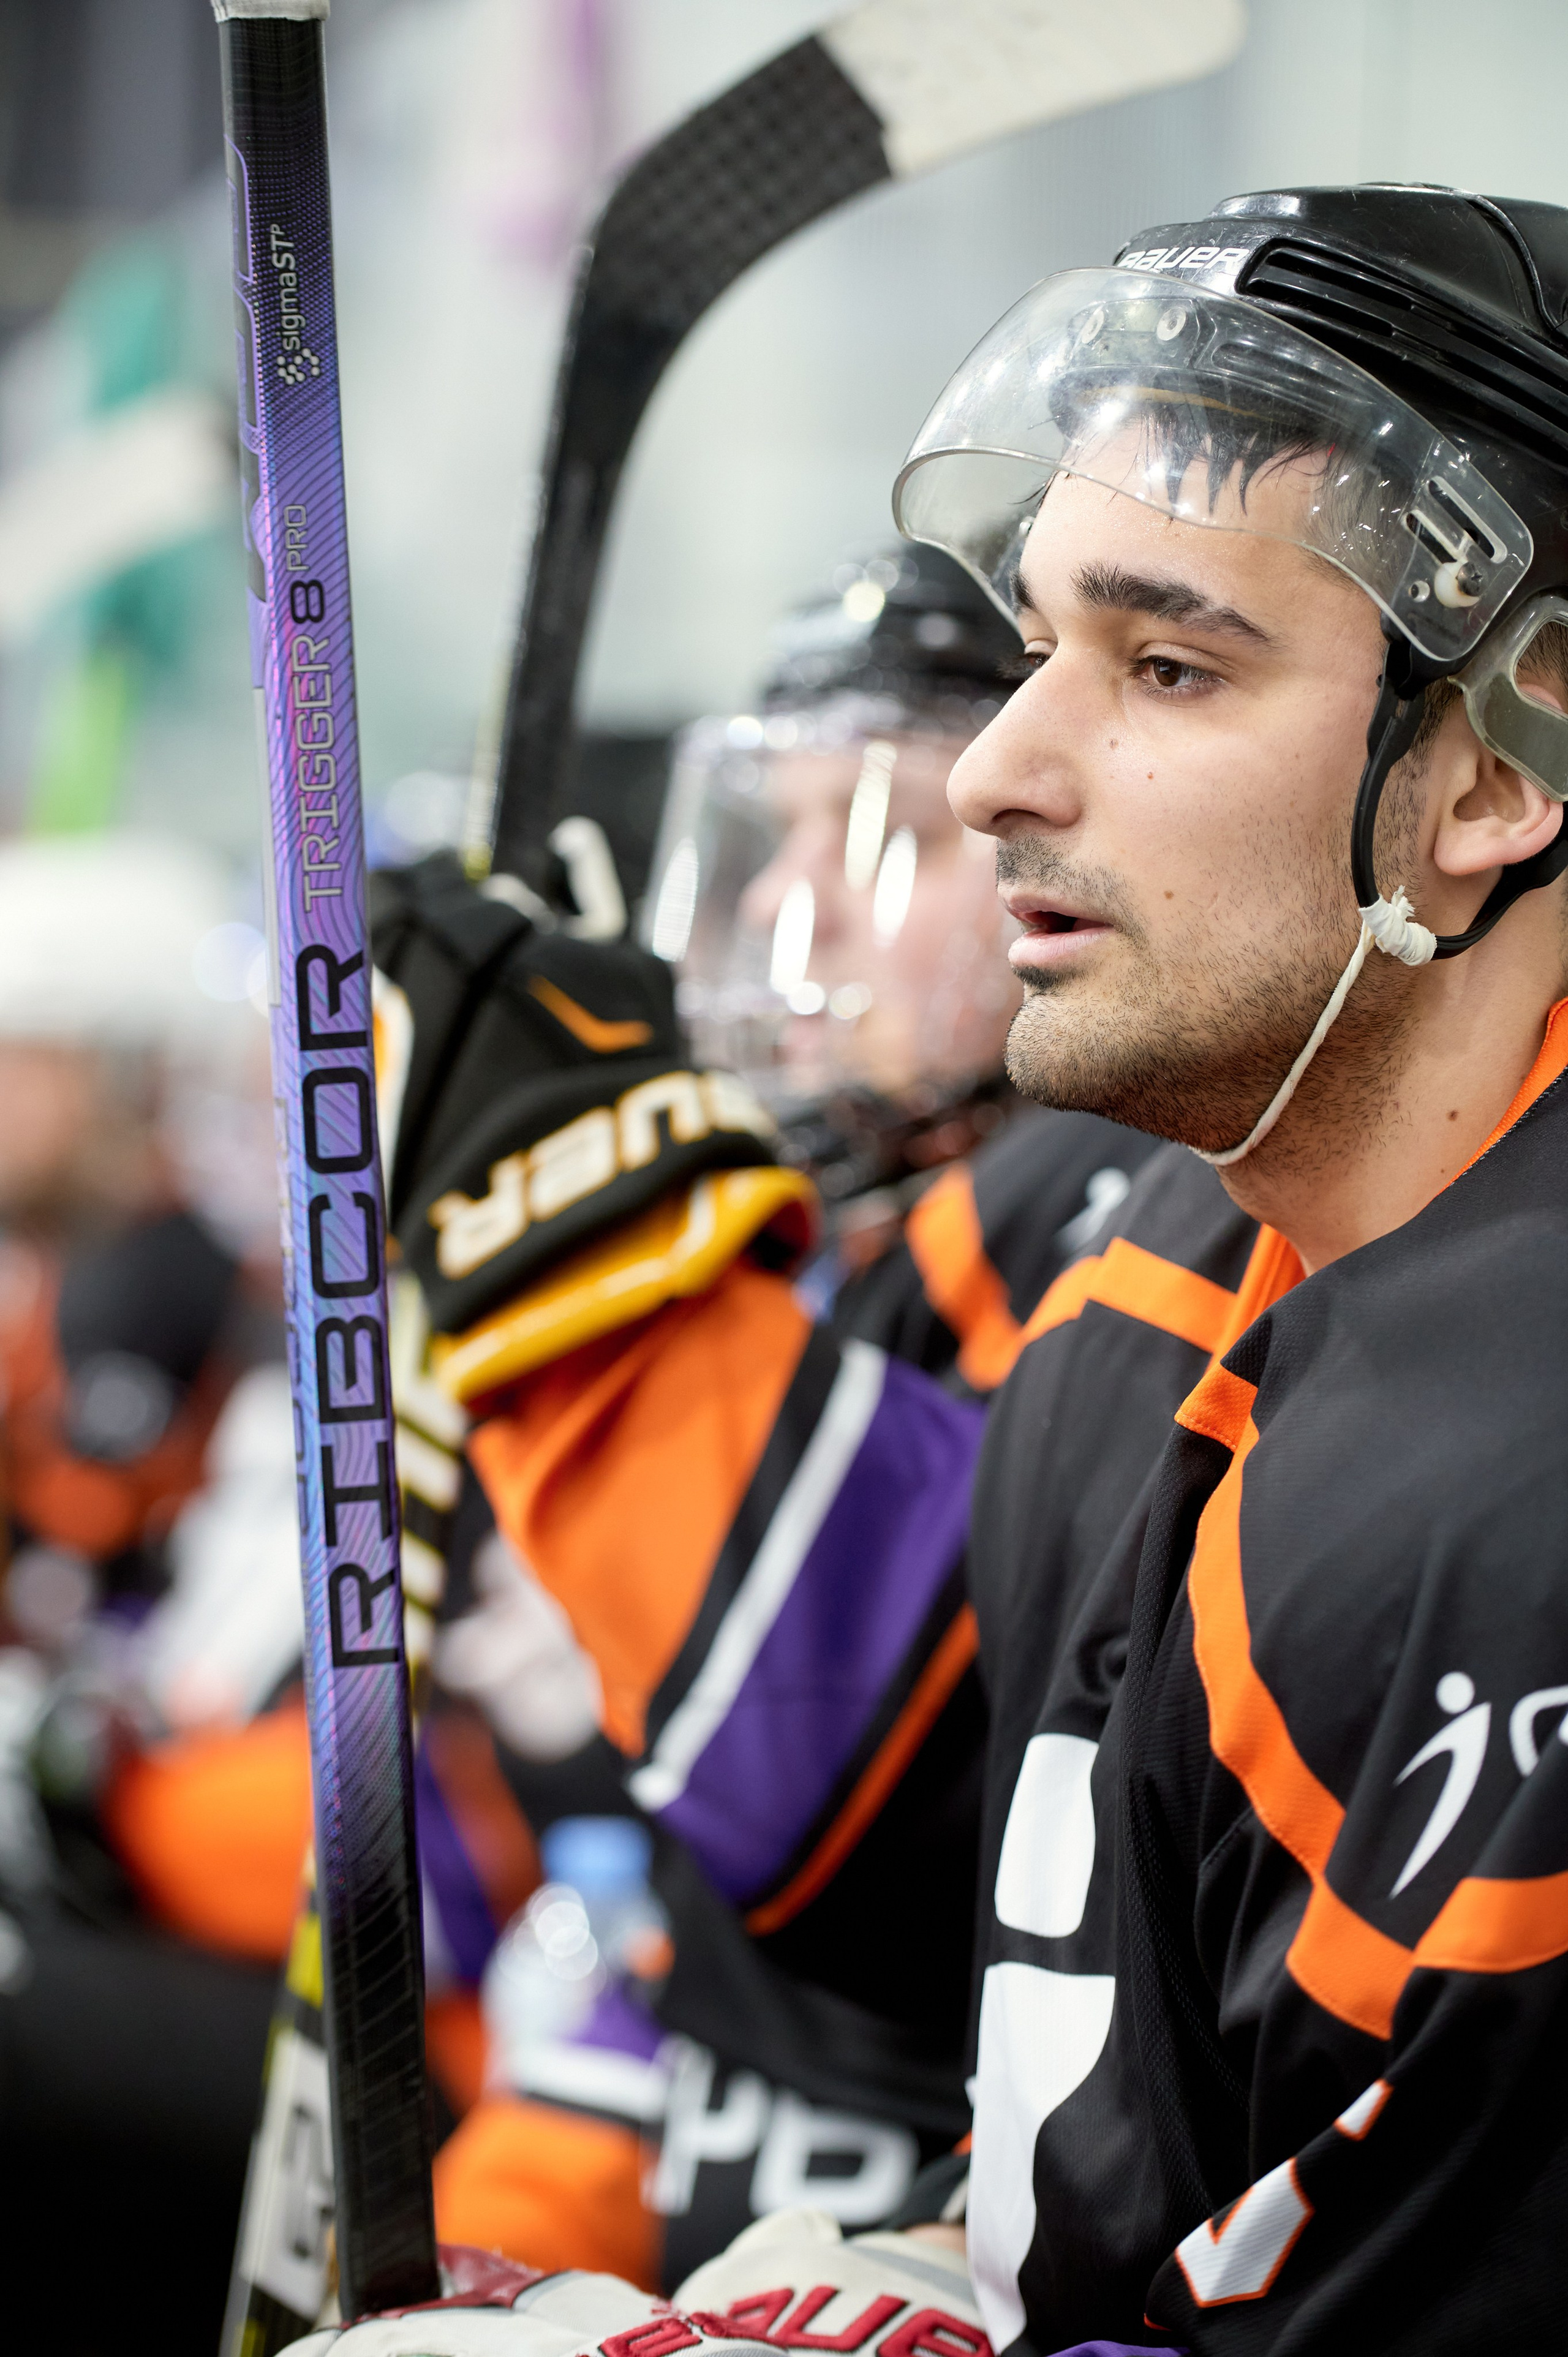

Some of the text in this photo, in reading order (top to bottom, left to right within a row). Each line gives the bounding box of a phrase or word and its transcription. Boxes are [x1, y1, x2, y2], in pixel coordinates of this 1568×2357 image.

[283, 504, 310, 572] PRO
[428, 1069, 777, 1280] AUER
[295, 943, 400, 1669] RIBCOR
